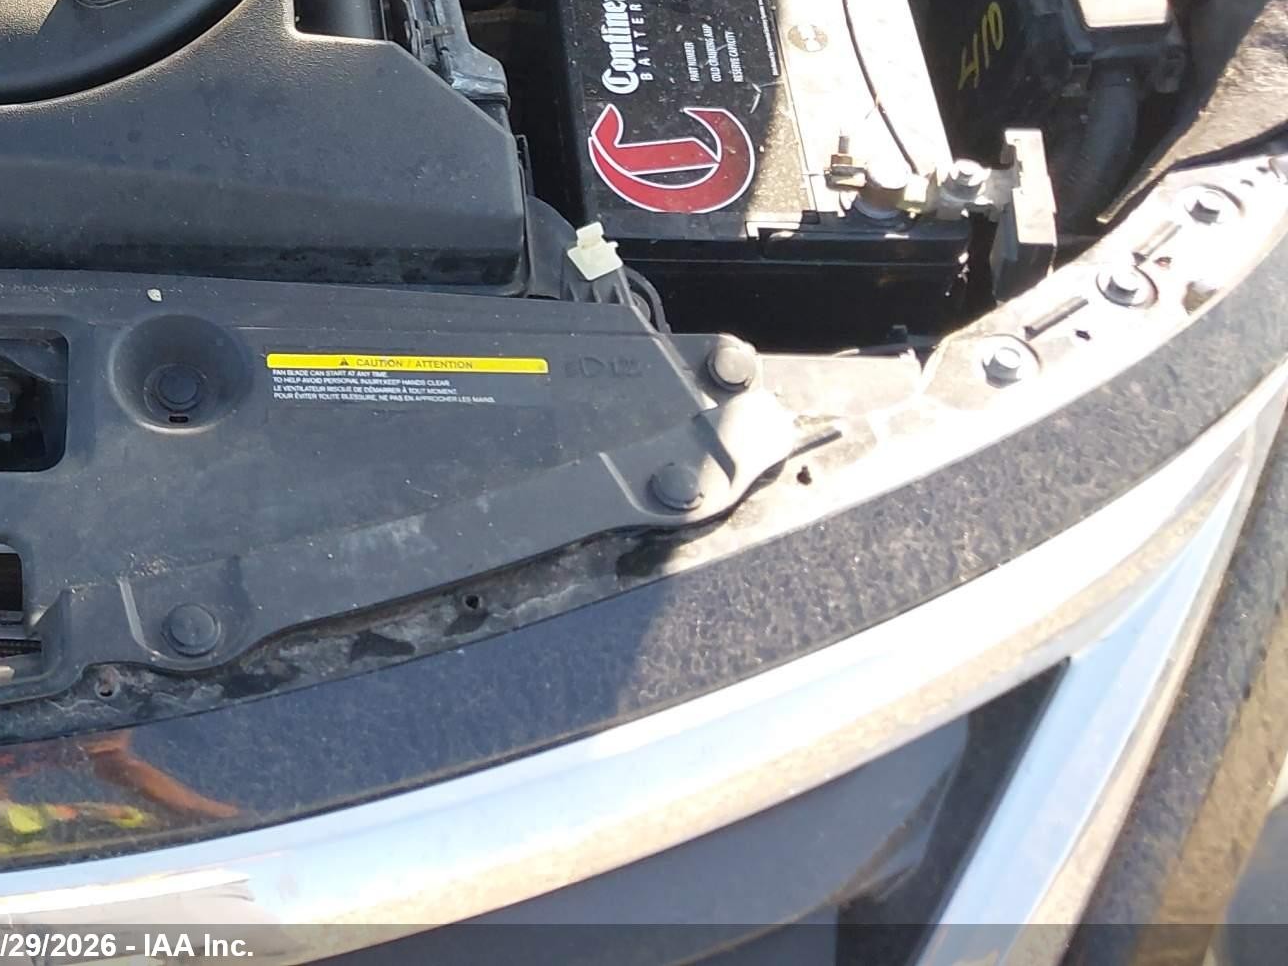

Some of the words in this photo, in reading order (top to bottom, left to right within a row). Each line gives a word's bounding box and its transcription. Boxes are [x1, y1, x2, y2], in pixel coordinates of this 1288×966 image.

[701, 24, 713, 37] AMP
[704, 37, 719, 65] CRANKING
[724, 30, 738, 56] CAPACITY
[684, 42, 696, 65] NUMBER
[688, 66, 700, 81] PART
[710, 66, 721, 81] COLD
[729, 57, 743, 82] RESERVE
[356, 358, 402, 367] CAUTION
[415, 359, 472, 368] ATTENTION
